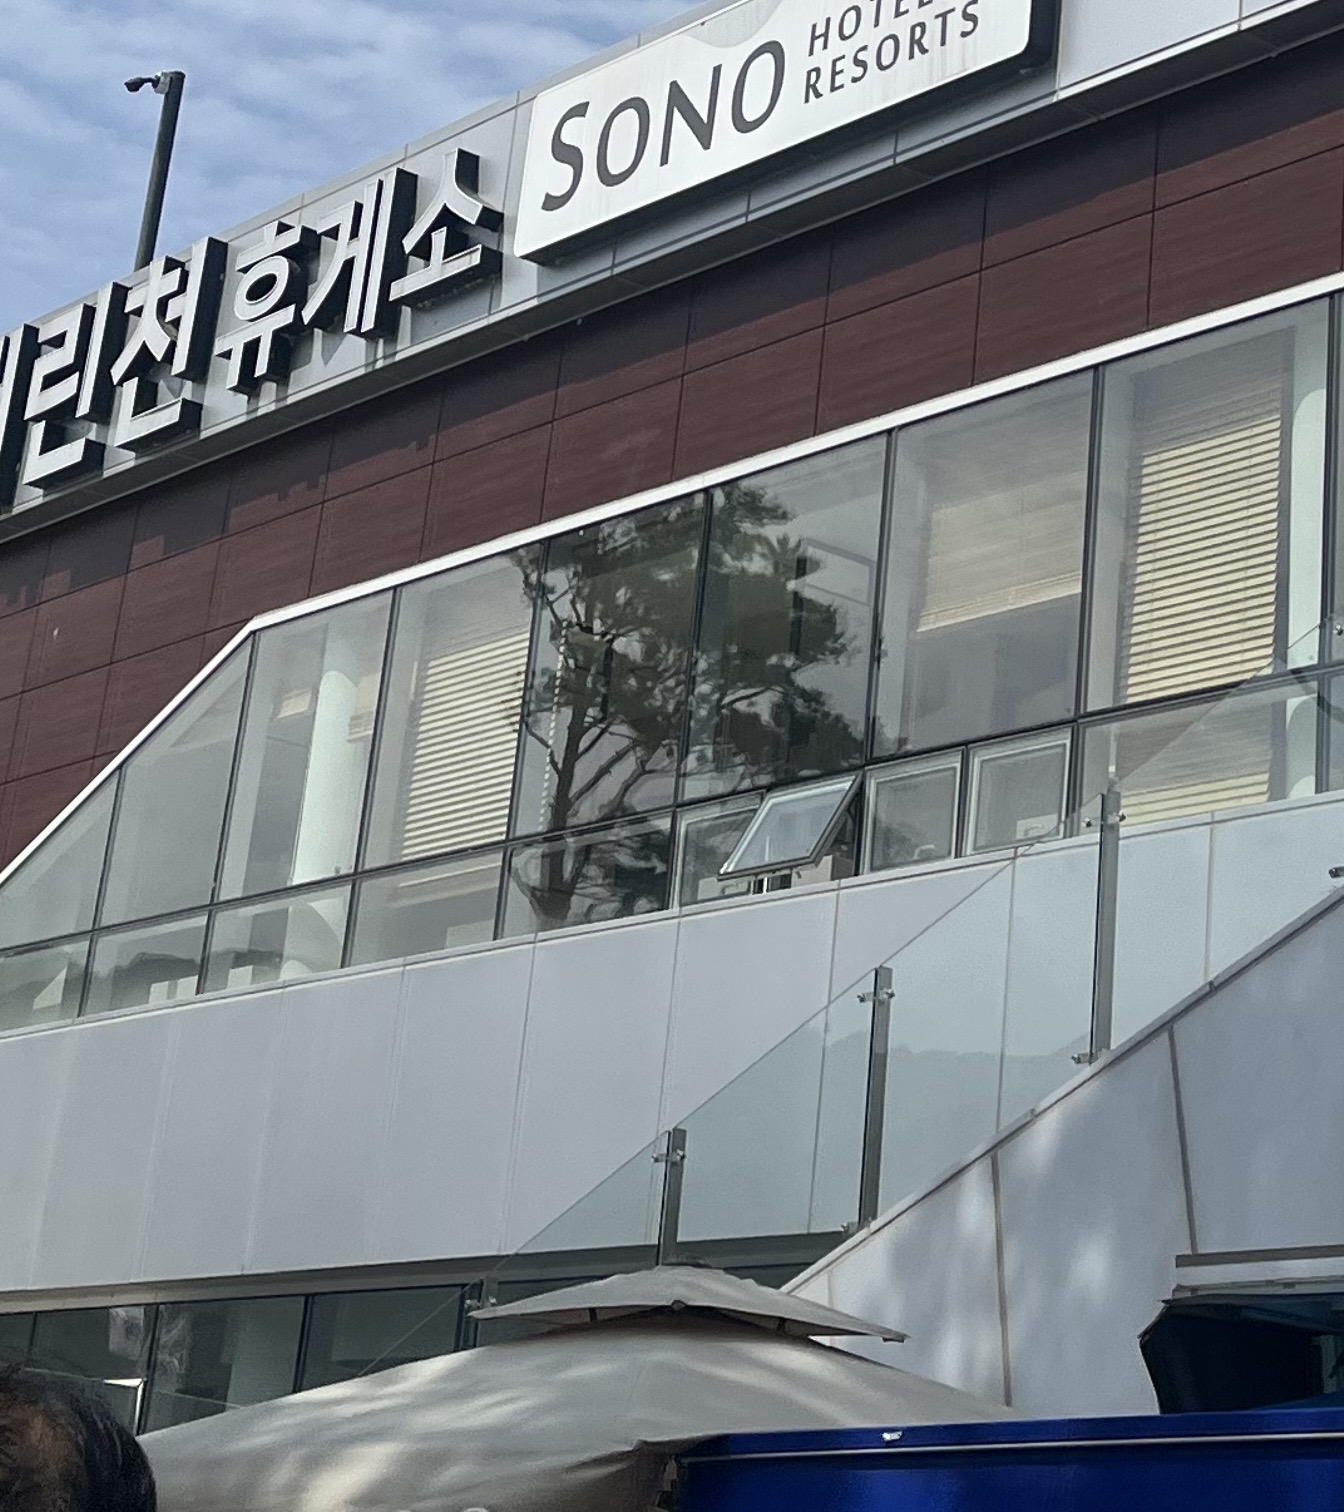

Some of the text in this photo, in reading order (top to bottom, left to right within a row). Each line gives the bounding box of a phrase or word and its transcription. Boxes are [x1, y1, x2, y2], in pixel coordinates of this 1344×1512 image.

[540, 39, 786, 212] SONO
[803, 0, 981, 104] RESORTS
[216, 147, 490, 384] 휴게소
